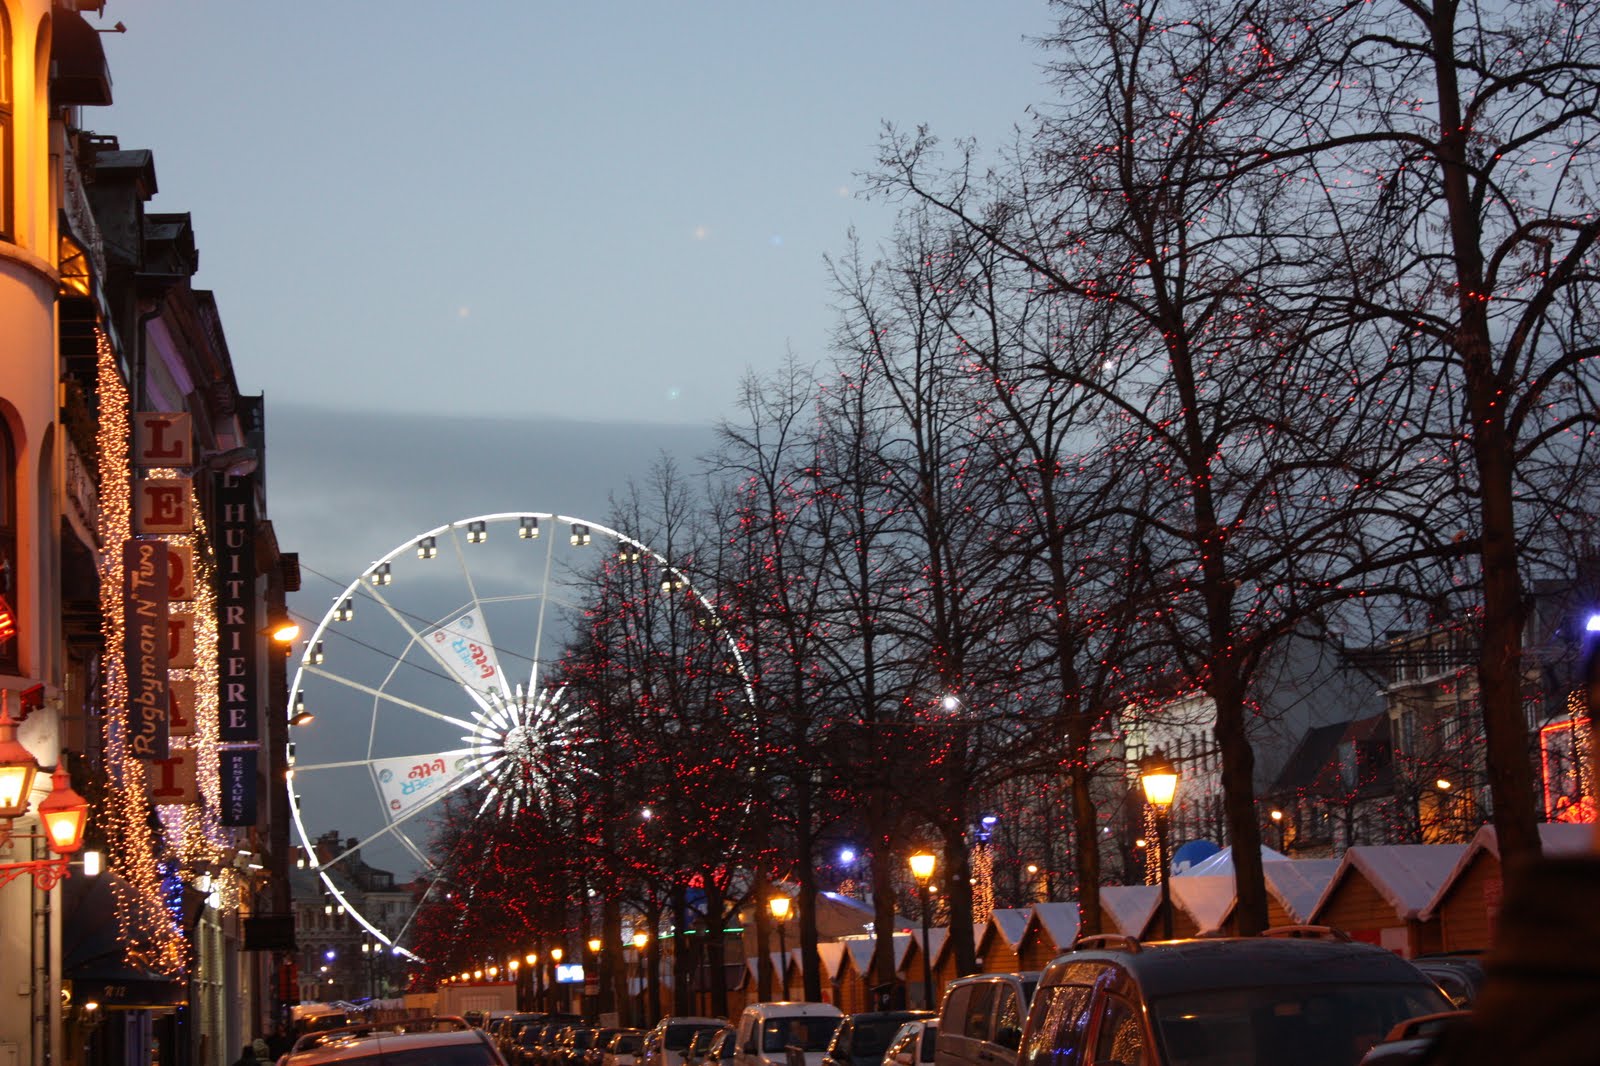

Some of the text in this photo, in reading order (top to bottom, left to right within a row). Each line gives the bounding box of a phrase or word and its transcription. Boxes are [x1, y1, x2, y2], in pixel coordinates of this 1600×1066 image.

[131, 544, 155, 592] Two
[133, 624, 165, 755] Rugbyman
[231, 756, 244, 821] RESTAURANT
